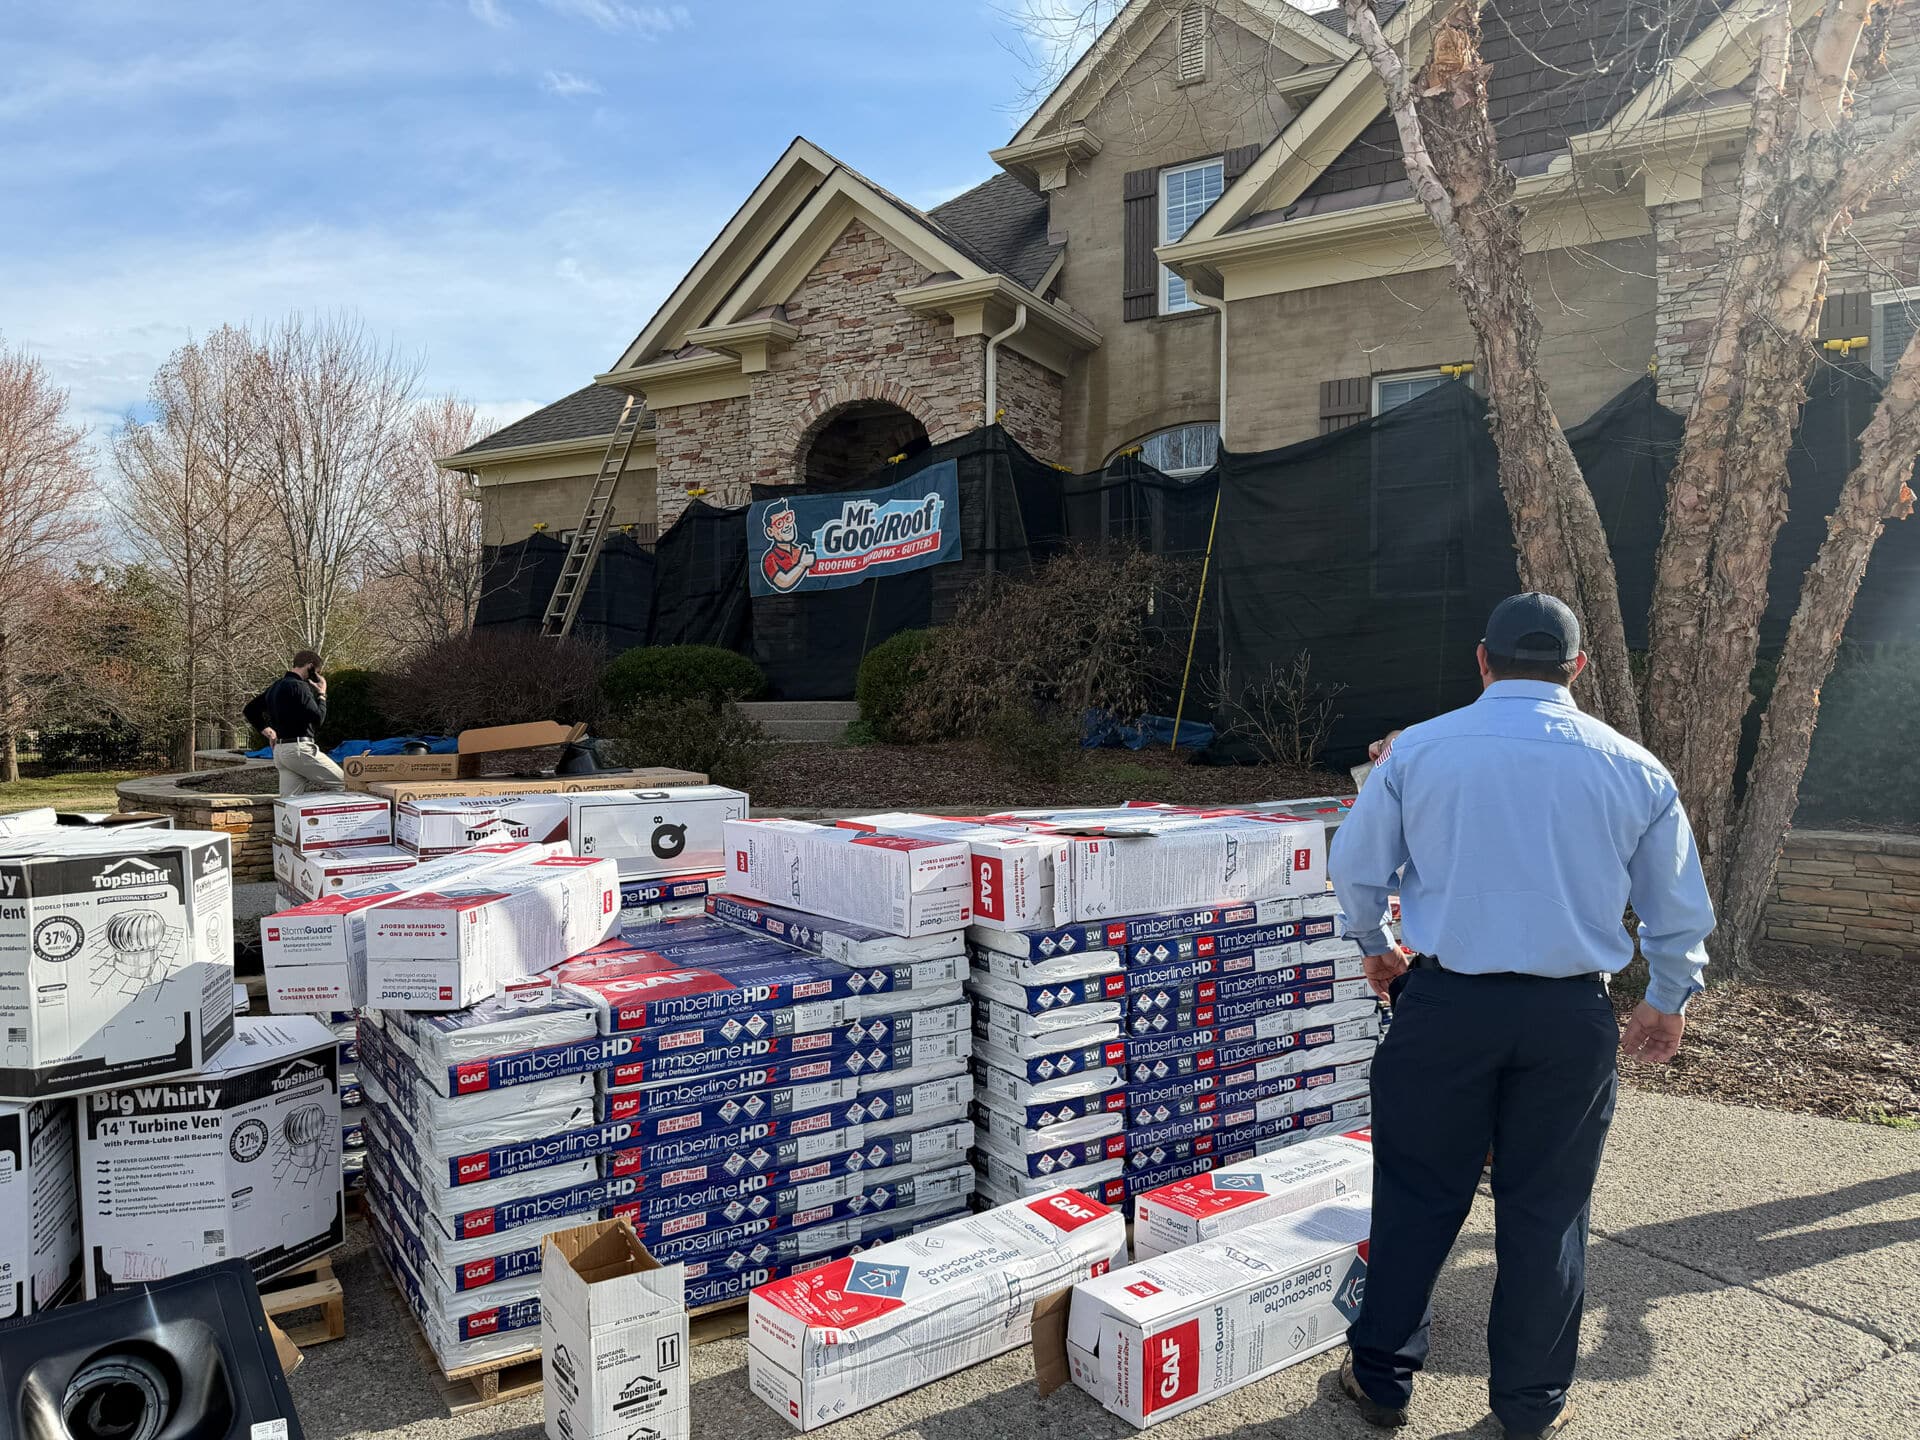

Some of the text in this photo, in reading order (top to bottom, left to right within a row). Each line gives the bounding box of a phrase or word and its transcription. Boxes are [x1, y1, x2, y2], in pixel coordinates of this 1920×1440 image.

[846, 504, 876, 527] Mr.
[824, 499, 938, 554] GoodRoof
[818, 559, 856, 572] ROOFING
[901, 536, 933, 555] GUTTERS
[651, 824, 687, 860] Q
[92, 868, 170, 889] TopShield
[980, 862, 993, 914] GAF
[281, 925, 333, 937] StormGuard
[44, 930, 72, 946] 37%
[894, 967, 912, 979] SW
[605, 971, 700, 993] GAF
[1107, 981, 1123, 992] GAF
[382, 991, 437, 1001] StormGuard
[1200, 988, 1214, 998] GAF
[621, 1008, 645, 1021] GAF
[1198, 1012, 1214, 1022] GAF
[1084, 1050, 1099, 1062] SW
[1107, 1049, 1124, 1060] GAF
[1199, 1056, 1214, 1066] GAF
[1178, 1056, 1191, 1068] SW
[272, 1063, 325, 1093] TopShield
[460, 1071, 486, 1085] GAF
[500, 1076, 518, 1086] High
[519, 1070, 554, 1083] Definition
[614, 1099, 638, 1111] GAF
[896, 1094, 912, 1106] SW
[1108, 1100, 1124, 1110] GAF
[1179, 1101, 1192, 1112] SW
[1200, 1101, 1215, 1110] GAF
[1086, 1101, 1100, 1113] SW
[100, 1121, 125, 1137] 14"
[129, 1118, 188, 1134] Turbine
[104, 1139, 122, 1148] with
[123, 1136, 173, 1147] Perma-Lube
[174, 1134, 190, 1142] Ball
[239, 1131, 259, 1148] 37%
[1086, 1144, 1100, 1156] SW
[1108, 1143, 1124, 1153] GAF
[1175, 1142, 1189, 1154] SW
[1197, 1142, 1212, 1152] GAF
[138, 1155, 170, 1164] GUARANTEE
[500, 1164, 517, 1175] High
[519, 1157, 553, 1169] Definition
[460, 1161, 486, 1174] GAF
[1280, 1158, 1351, 1184] Underlayment
[1271, 1169, 1291, 1180] Peel
[898, 1182, 914, 1195] SW
[1107, 1187, 1123, 1198] GAF
[778, 1190, 797, 1202] SW
[1050, 1197, 1095, 1219] GAF
[465, 1215, 491, 1228] GAF
[780, 1238, 797, 1250] SW
[918, 1247, 997, 1279] Sous-couche
[929, 1249, 1022, 1286] à peler et coller
[465, 1265, 491, 1279] GAF
[1132, 1283, 1155, 1295] GAF
[1249, 1265, 1332, 1306] à peler et coller
[1264, 1280, 1332, 1314] Sous-couche
[1213, 1307, 1223, 1389] StormGuard
[1160, 1338, 1180, 1398] GAF
[619, 1380, 662, 1401] TopShield
